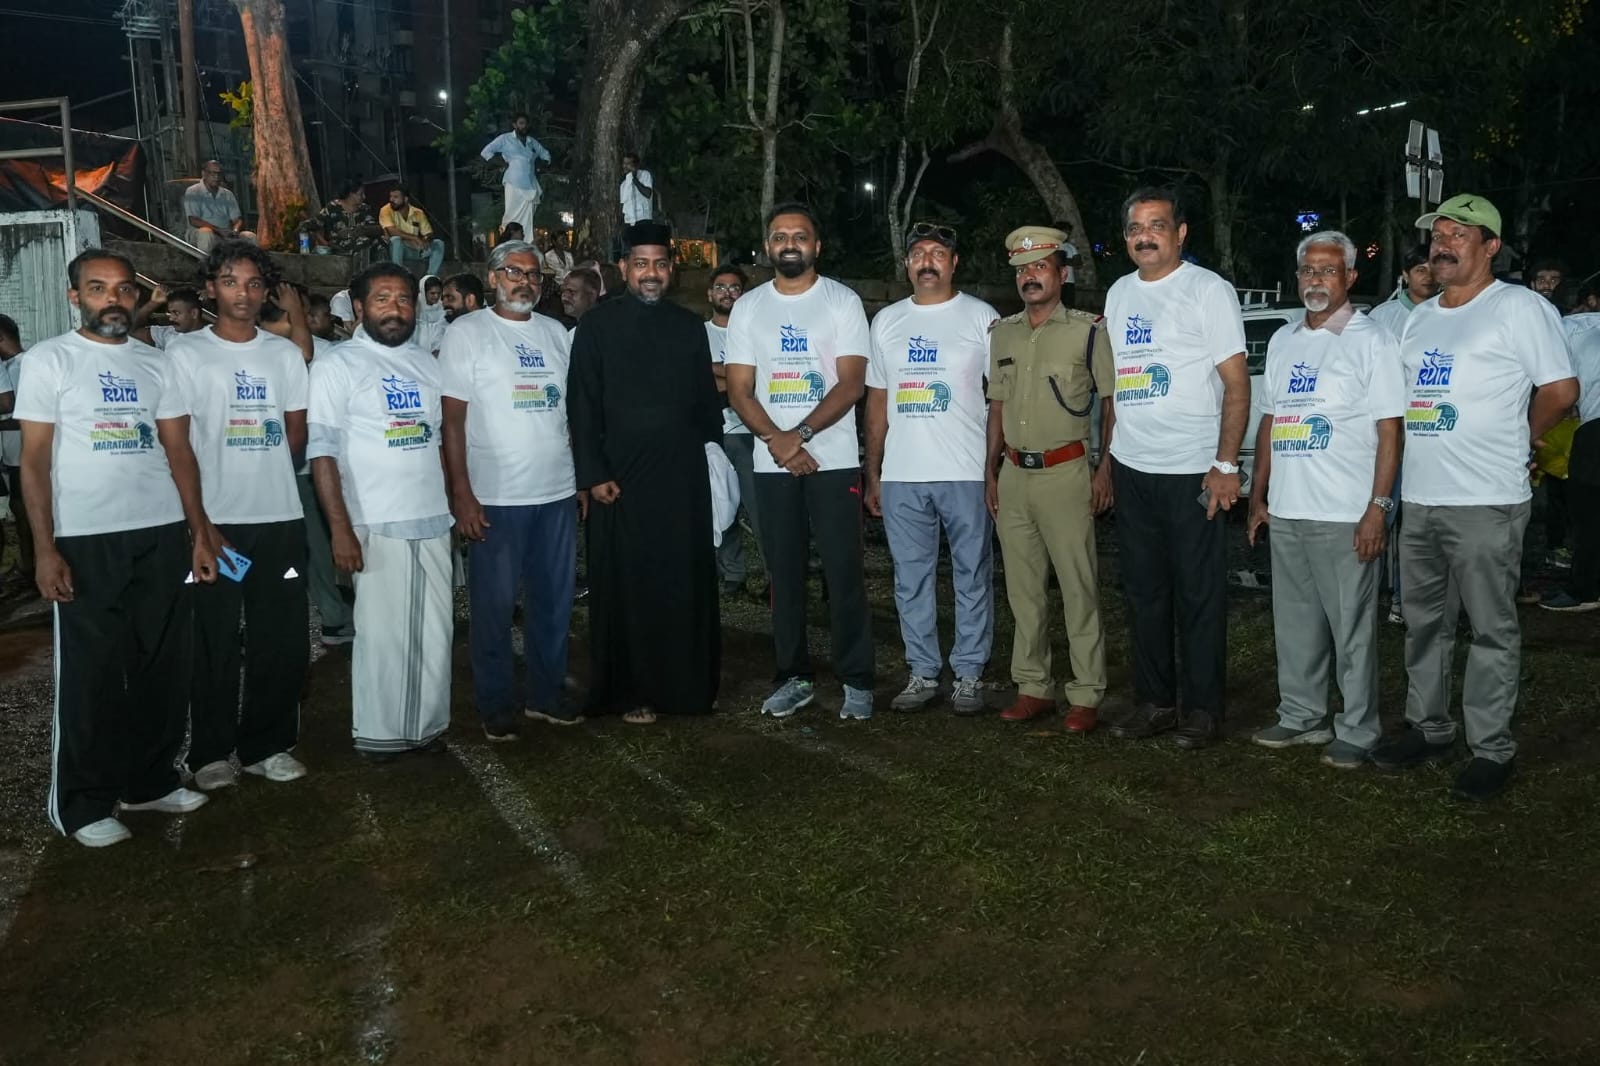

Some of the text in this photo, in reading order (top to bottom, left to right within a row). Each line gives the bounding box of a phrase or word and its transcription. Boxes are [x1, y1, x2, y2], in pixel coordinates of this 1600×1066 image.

[1126, 329, 1152, 345] RUN
[781, 338, 808, 352] RUN
[519, 356, 545, 367] RUN
[908, 349, 938, 363] RUN
[1416, 367, 1452, 385] RUN
[1117, 382, 1169, 402] MARATHON 2.0
[1288, 377, 1317, 393] RUN
[102, 388, 138, 402] RUN
[236, 386, 266, 400] RUN
[769, 388, 824, 403] MARATHON 2.0
[386, 391, 422, 410] RUN
[897, 399, 949, 413] MARATHON 2.0
[1407, 418, 1455, 431] MARATHON 2.0
[93, 440, 138, 451] MARATHON
[226, 437, 264, 447] MARATHON
[1272, 434, 1330, 451] MARATHON 2.0
